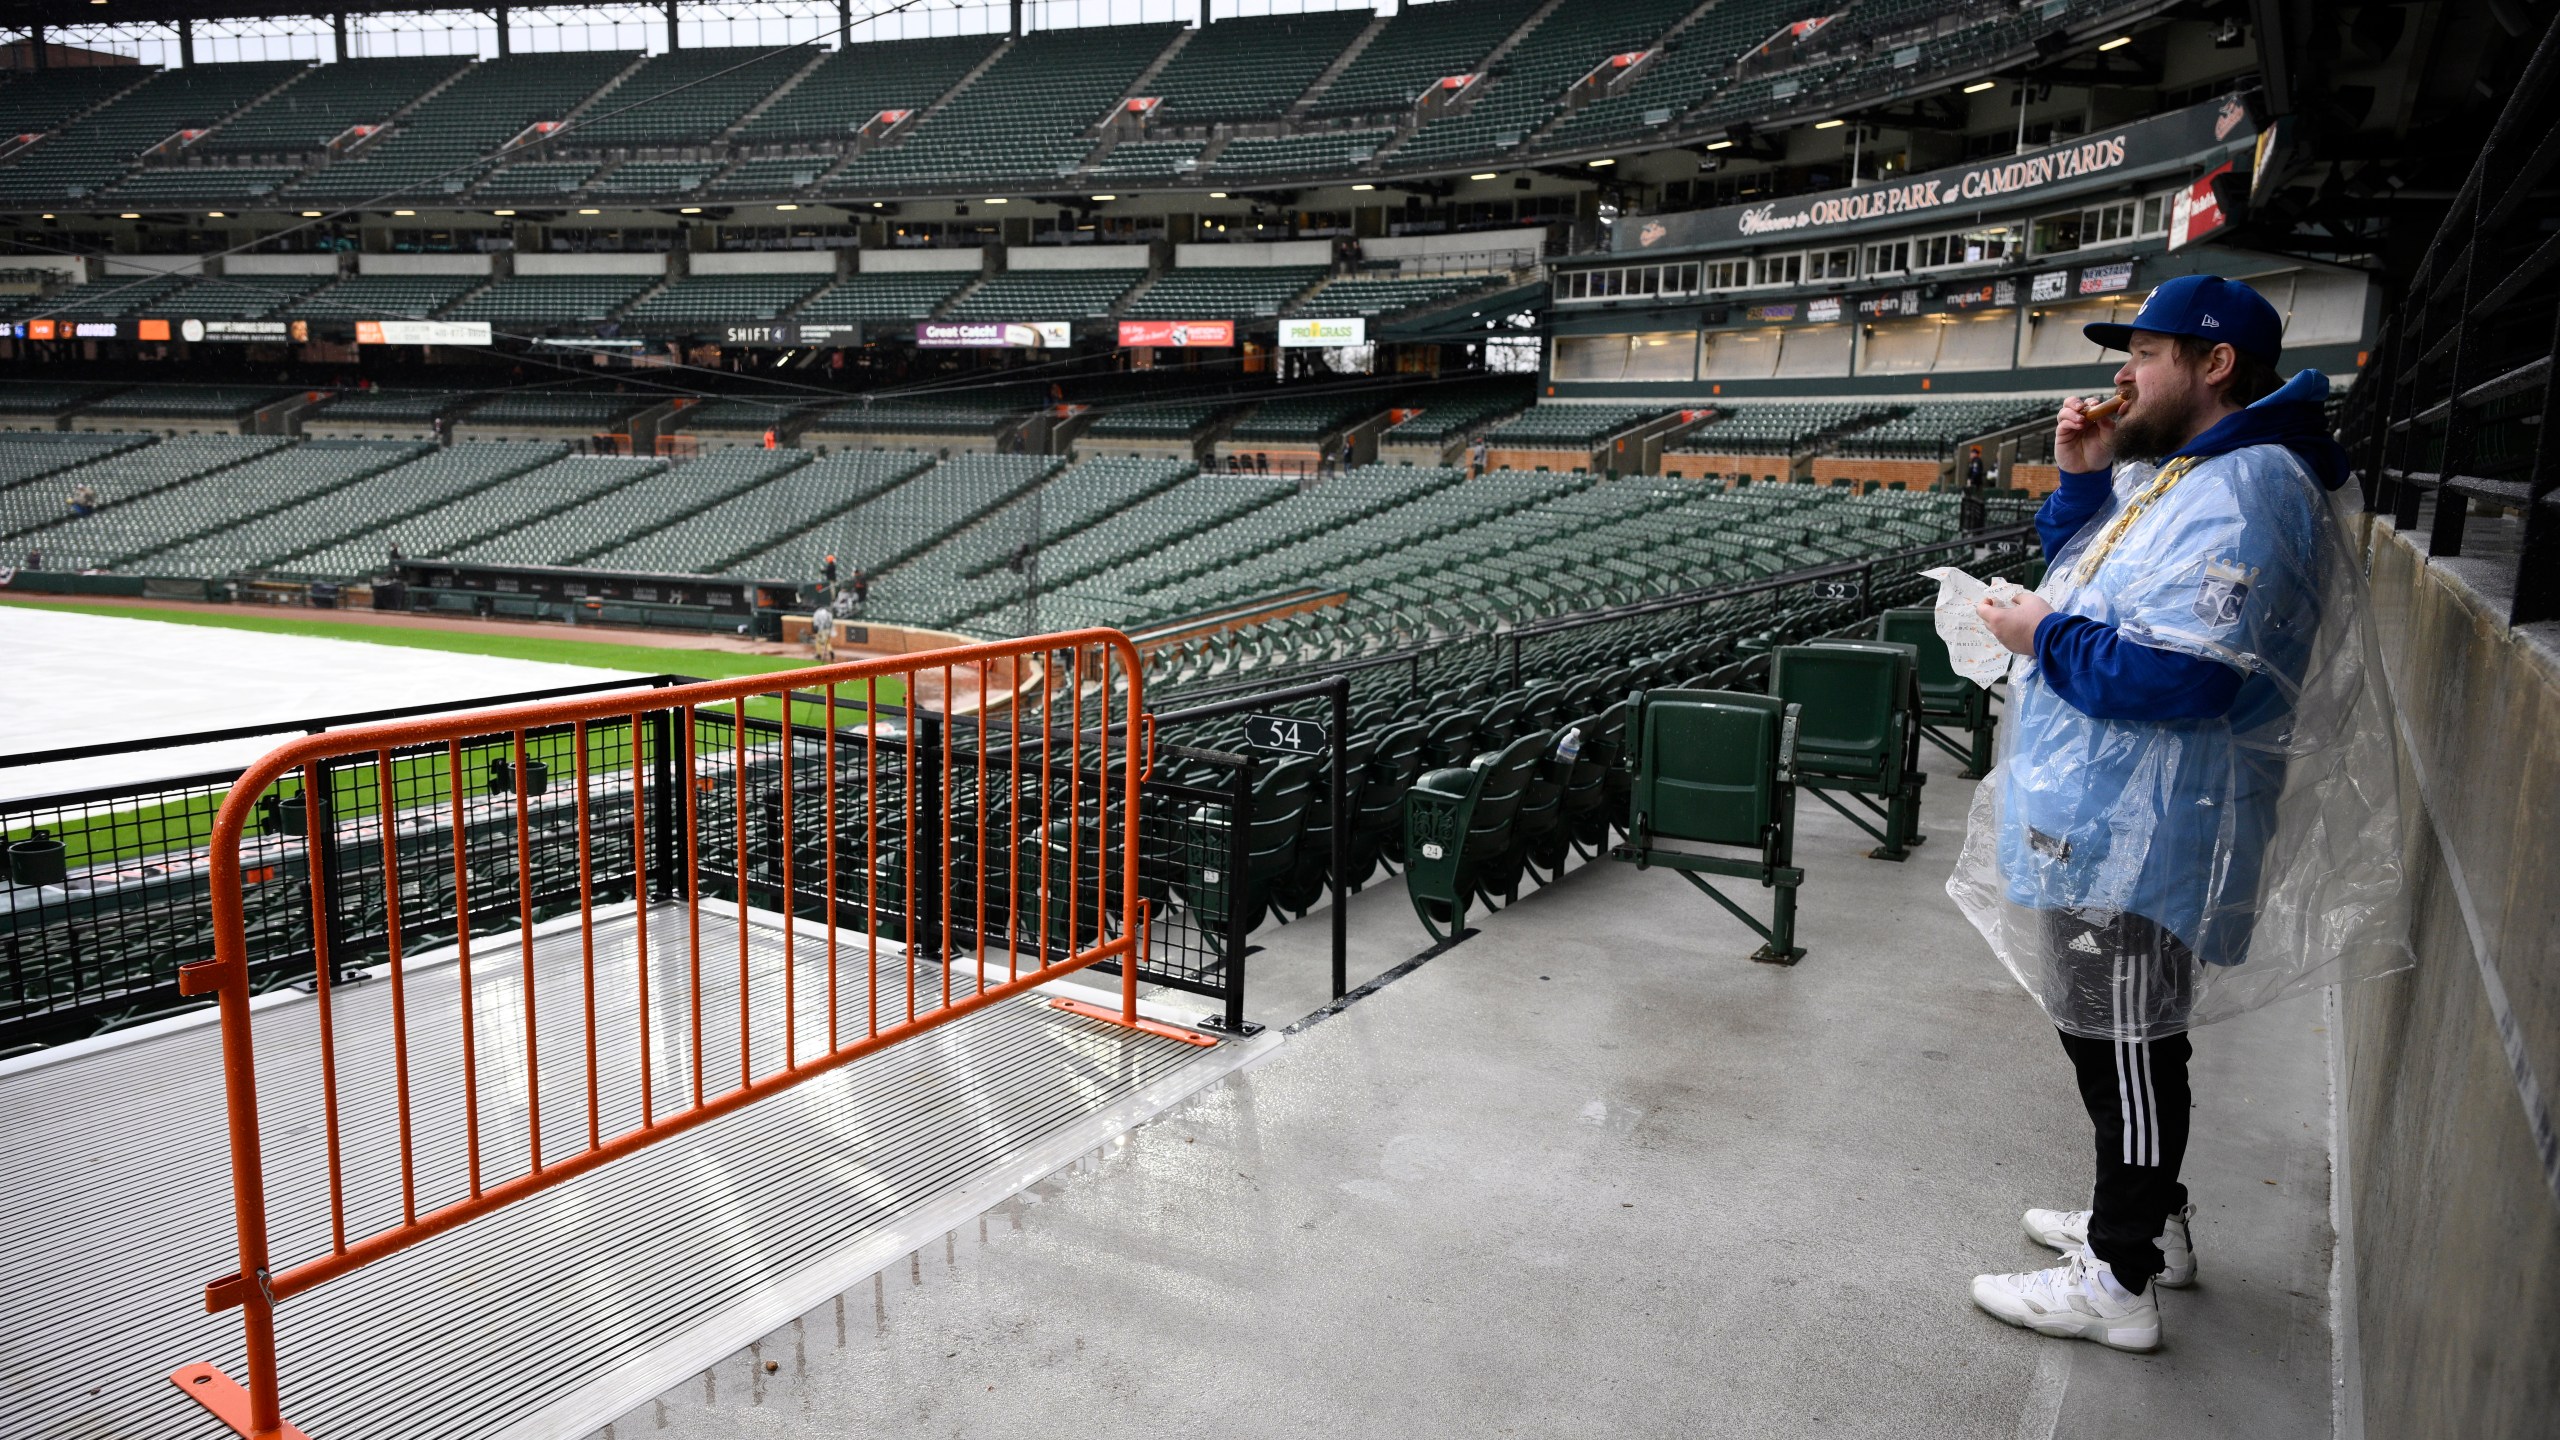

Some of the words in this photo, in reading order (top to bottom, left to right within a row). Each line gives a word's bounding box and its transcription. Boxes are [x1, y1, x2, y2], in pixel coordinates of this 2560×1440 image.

[1739, 203, 1796, 236] Welcome
[1796, 210, 1810, 228] to
[1810, 191, 1886, 225] ORIOLE
[1887, 180, 1940, 214] PARK
[1942, 184, 1960, 204] at
[1962, 154, 2056, 199] CAMDEN
[2056, 135, 2126, 180] YARDS
[2082, 262, 2134, 279] NEWSTALK
[1809, 298, 1840, 311] WBAL
[926, 325, 958, 338] Great
[959, 325, 997, 338] Catch!
[1291, 327, 1310, 338] PRO
[1320, 326, 1352, 337] GRASS
[1827, 584, 1845, 598] 52
[2199, 580, 2242, 620] KC
[1269, 721, 1301, 749] 54
[1426, 846, 1438, 857] 24
[2068, 940, 2102, 954] adidas
